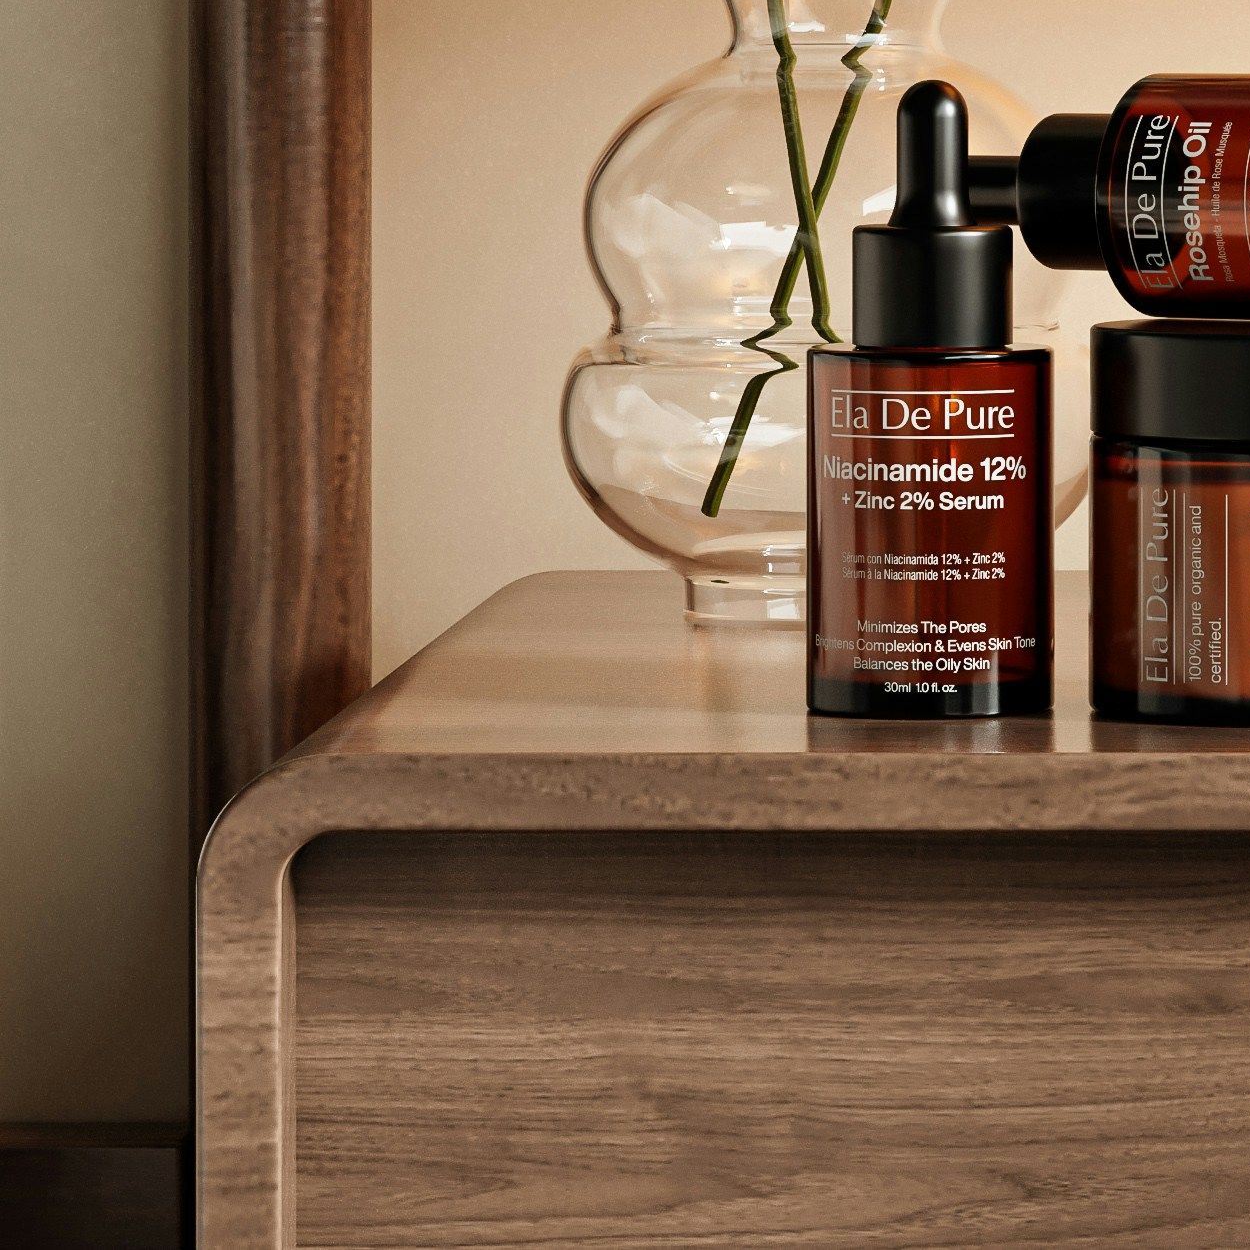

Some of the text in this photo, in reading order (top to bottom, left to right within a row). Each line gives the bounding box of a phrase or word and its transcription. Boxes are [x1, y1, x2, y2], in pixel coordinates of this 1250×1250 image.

[1212, 158, 1223, 179] Rose
[1212, 180, 1220, 191] de
[1131, 114, 1175, 289] Ela De Pure
[1177, 122, 1214, 281] Rosehip Oil
[1211, 193, 1220, 217] Huile
[1213, 225, 1228, 264] Mosqueta
[831, 395, 1014, 430] Ela De Pure
[823, 454, 1027, 482] Niacinamide 12%
[841, 491, 1005, 511] + Zinc 2% Serum
[867, 555, 881, 564] con
[884, 554, 938, 565] Niacinamida
[941, 553, 962, 565] 12%
[972, 553, 990, 564] Zinc
[991, 552, 1006, 564] 2%
[874, 568, 882, 580] la
[883, 569, 938, 580] Niacinamide
[941, 569, 961, 580] 12%
[972, 568, 990, 580] Zinc
[991, 568, 1006, 579] 2%
[1144, 488, 1168, 682] Ela De Pure
[1189, 505, 1204, 682] 100% pure organic and
[857, 620, 987, 634] Minimizes The Pores
[856, 639, 932, 654] Complexion
[934, 640, 945, 652] &
[948, 639, 987, 652] Evens
[988, 637, 1012, 651] Skin
[1014, 636, 1035, 649] Tone
[1209, 617, 1221, 683] certified.
[853, 657, 991, 673] Balances the Oily Skin
[884, 682, 911, 693] 30ml
[915, 682, 929, 693] 1.0
[942, 684, 957, 693] oz.
